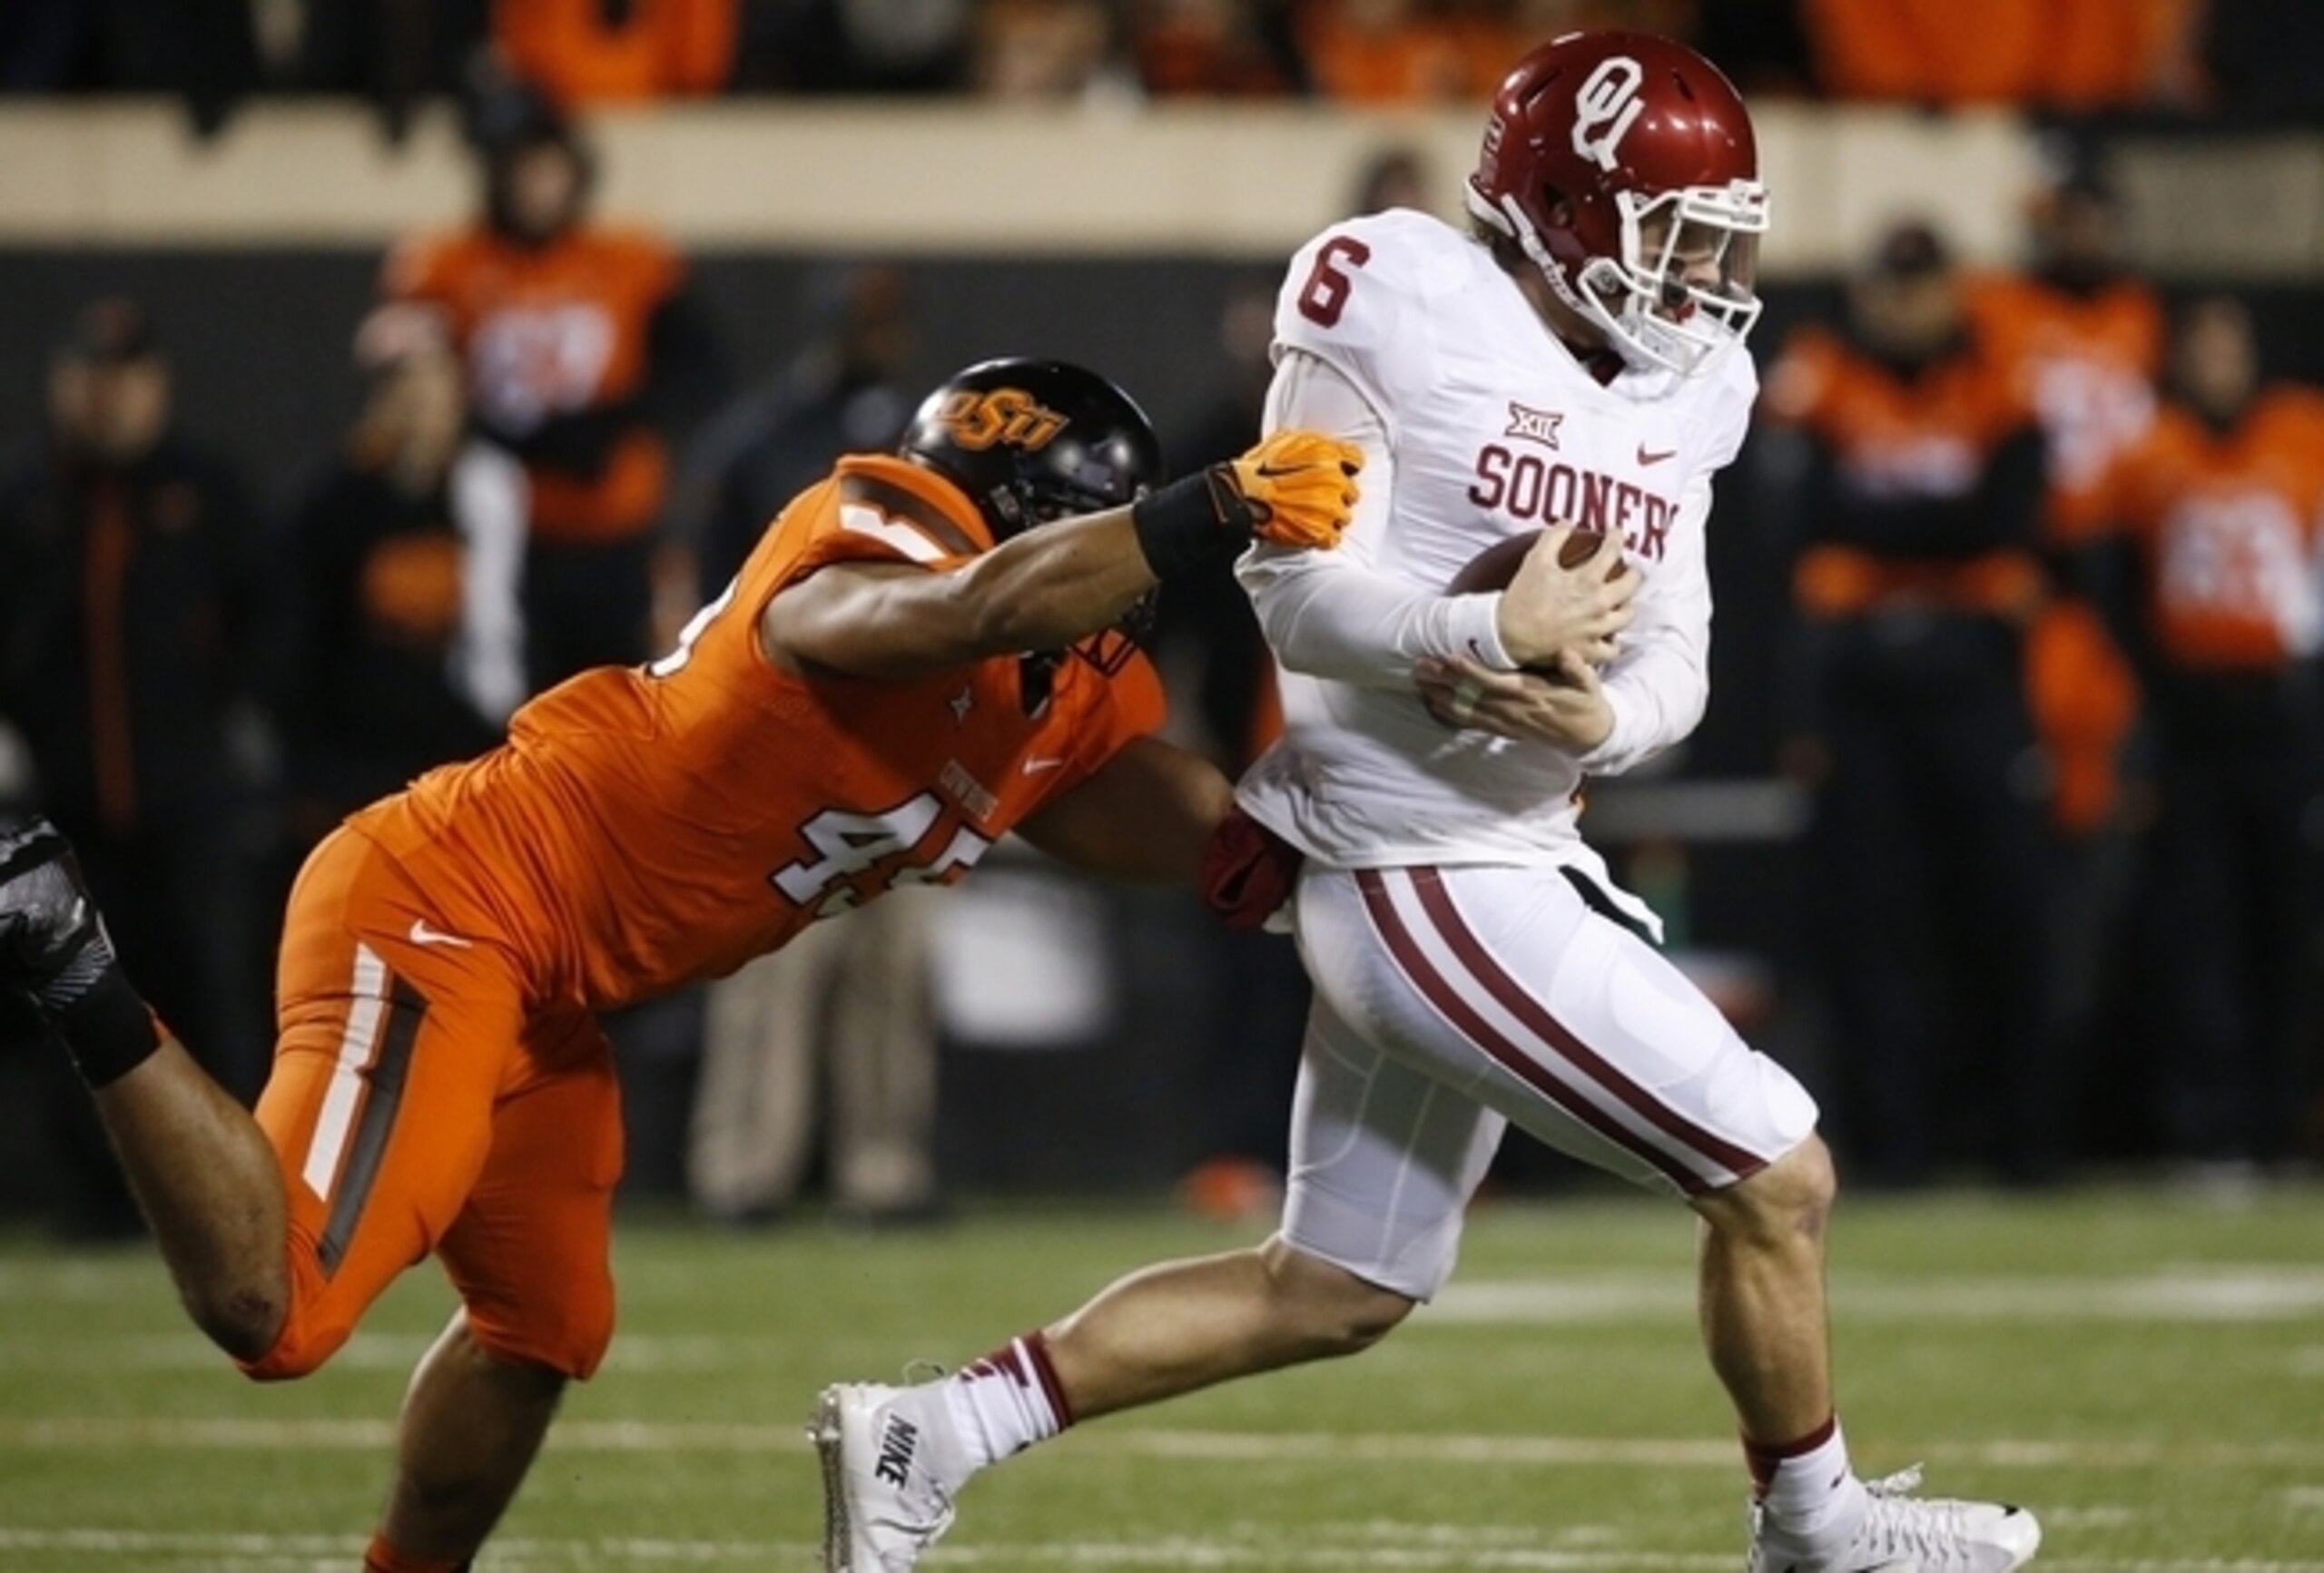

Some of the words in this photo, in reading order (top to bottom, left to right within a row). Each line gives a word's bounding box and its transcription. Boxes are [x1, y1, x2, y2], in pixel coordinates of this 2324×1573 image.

[1297, 235, 1371, 329] 6
[1467, 443, 1679, 562] SOONER
[875, 1411, 919, 1490] NIKE
